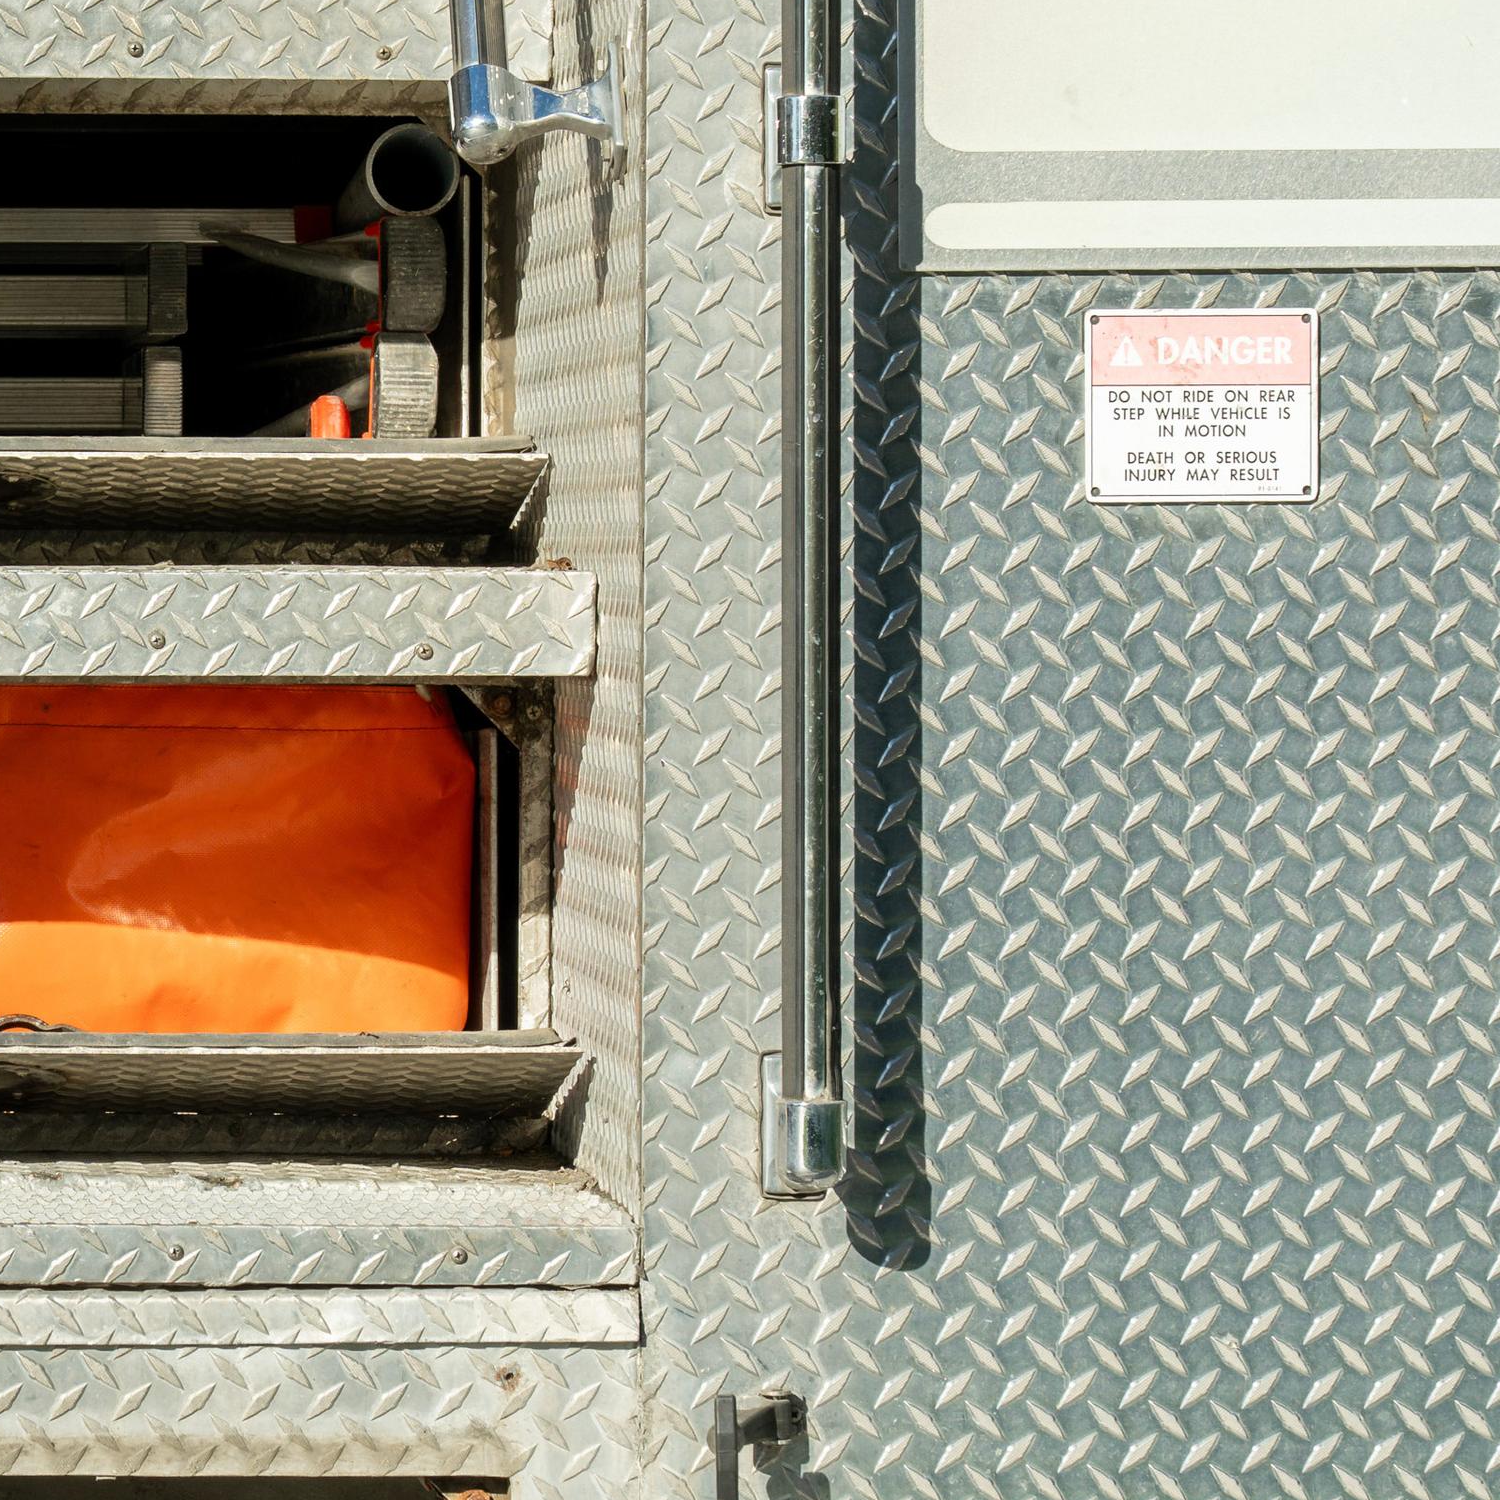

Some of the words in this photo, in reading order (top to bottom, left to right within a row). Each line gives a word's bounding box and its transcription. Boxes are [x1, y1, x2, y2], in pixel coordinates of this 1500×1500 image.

[1156, 335, 1294, 366] DANGER
[1108, 390, 1131, 404] DO
[1141, 390, 1173, 403] NOT
[1183, 390, 1214, 403] RIDE
[1224, 389, 1249, 403] ON
[1259, 389, 1295, 403] REAR
[1113, 407, 1145, 421] STEP
[1155, 407, 1200, 421] WHILE
[1210, 407, 1268, 420] VEHICLE
[1278, 406, 1291, 420] IS
[1158, 424, 1174, 438] IN
[1184, 424, 1246, 438] MOTION
[1127, 451, 1174, 465] DEATH
[1184, 451, 1206, 465] OR
[1216, 450, 1277, 464] SERIOUS
[1123, 468, 1176, 482] INJURY
[1186, 468, 1219, 481] MAY
[1230, 468, 1280, 481] RESULT
